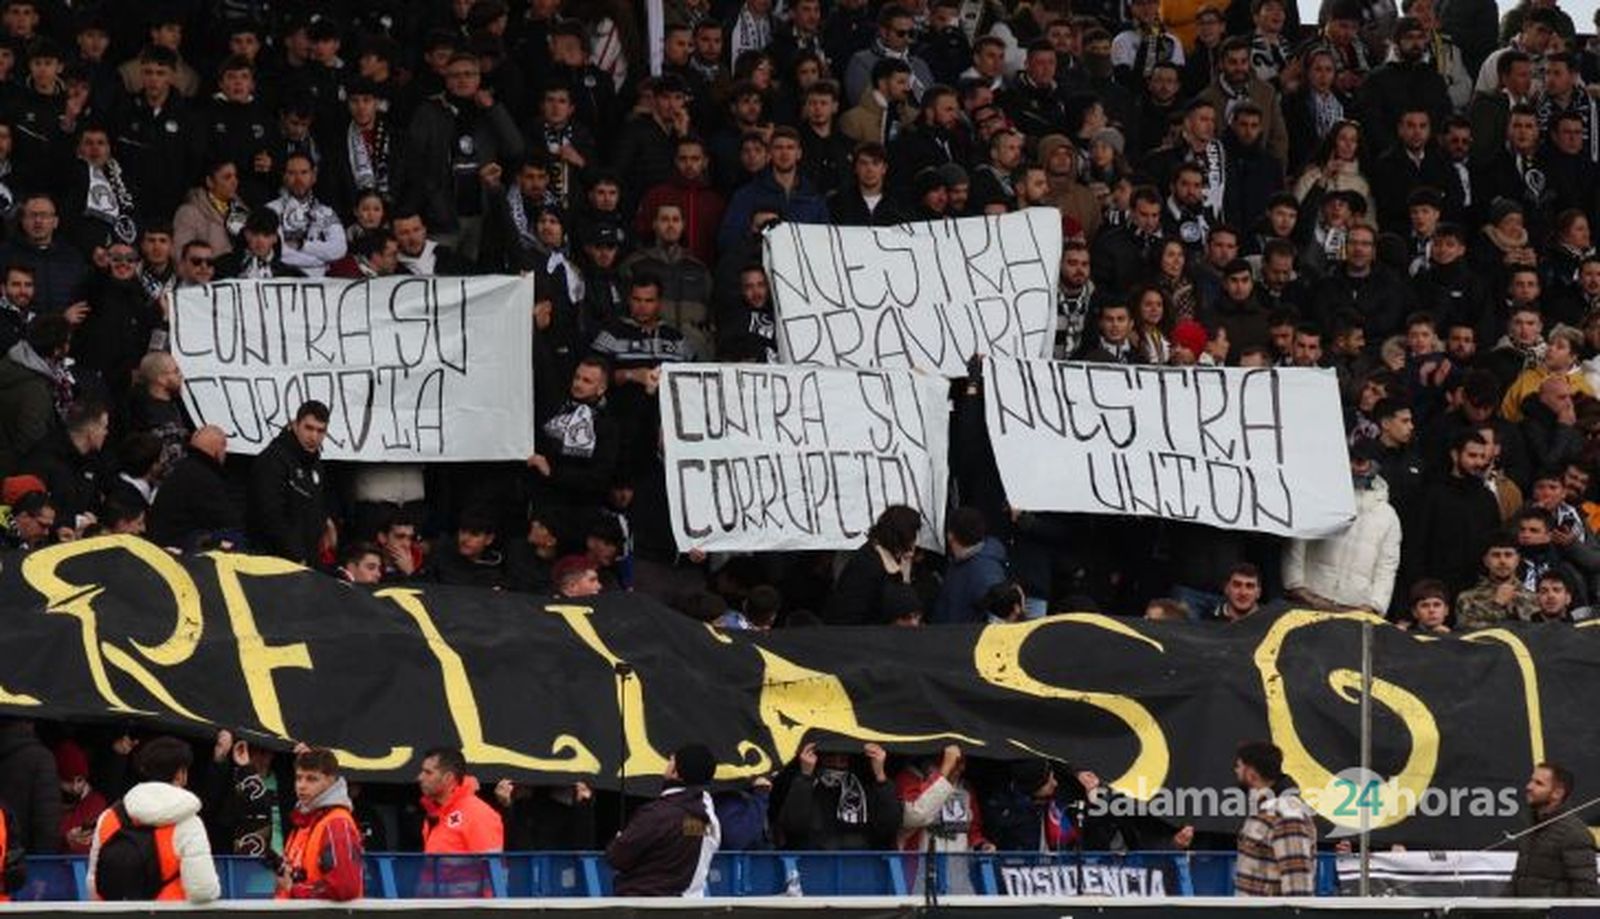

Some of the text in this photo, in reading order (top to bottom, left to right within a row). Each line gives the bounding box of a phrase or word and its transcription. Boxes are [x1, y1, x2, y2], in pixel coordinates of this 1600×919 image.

[763, 211, 1050, 310] NUESTRA
[173, 277, 467, 375] CONTRA SU
[668, 368, 928, 453] CONTRA SU
[989, 357, 1284, 465] NUESTRA
[1001, 864, 1167, 897] DISIDENCIA
